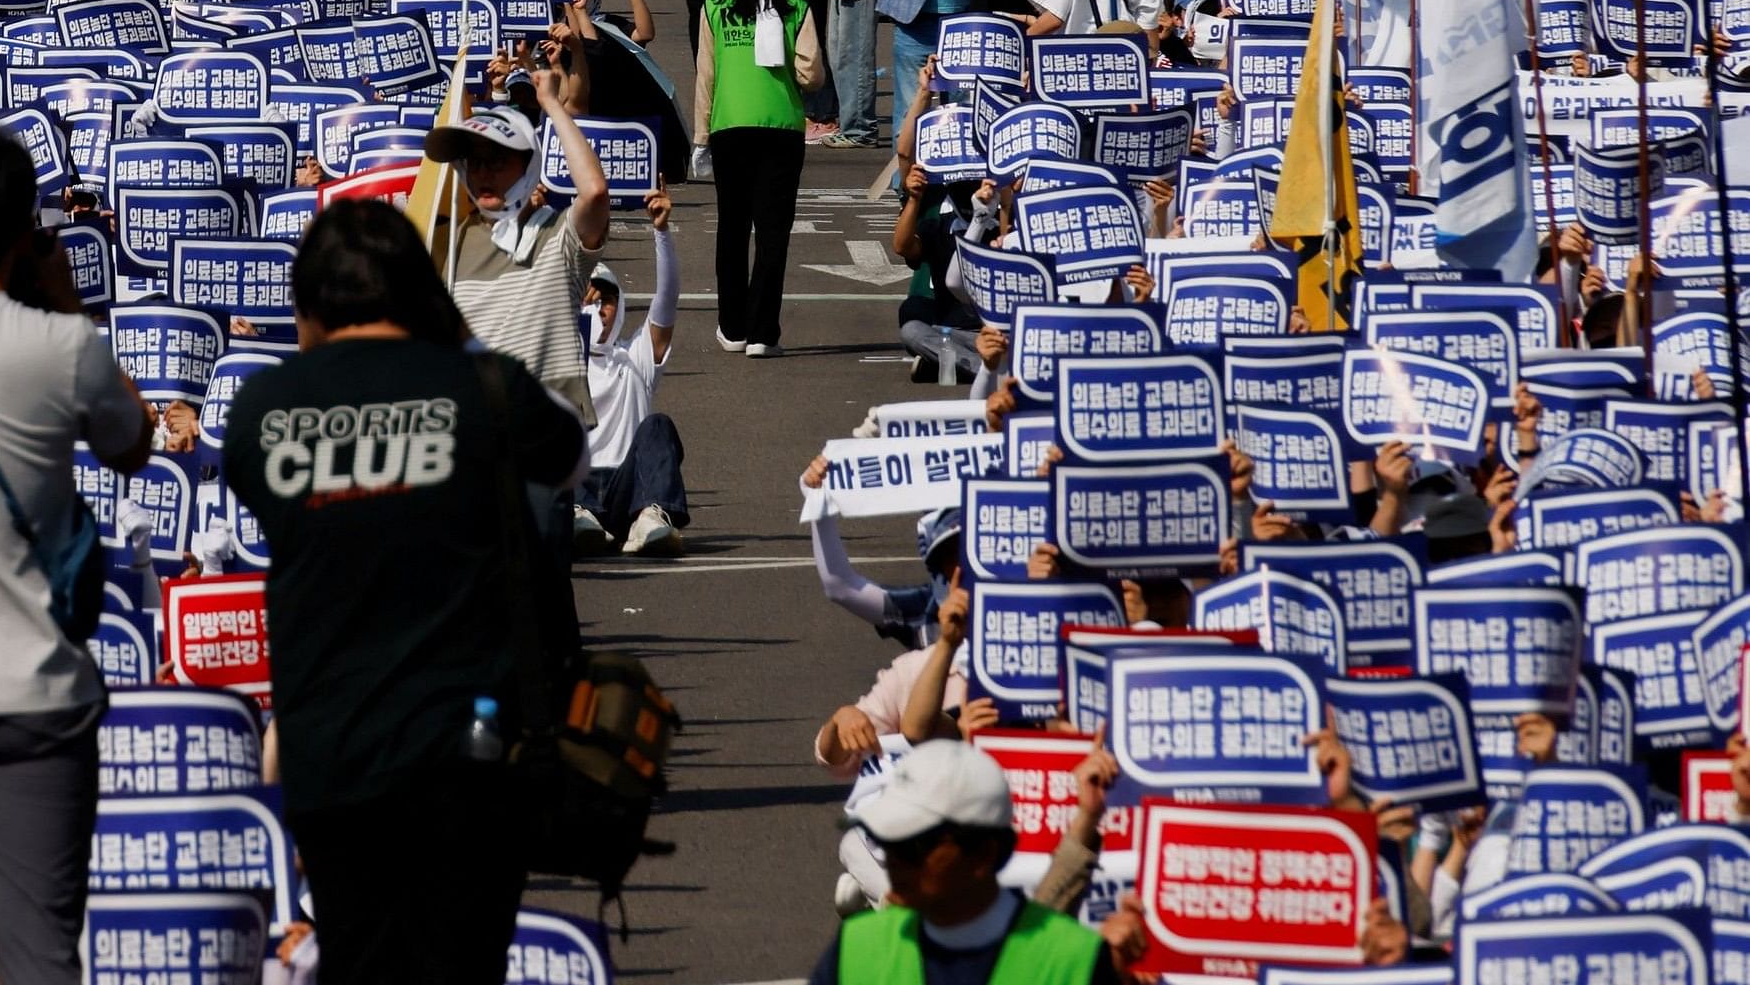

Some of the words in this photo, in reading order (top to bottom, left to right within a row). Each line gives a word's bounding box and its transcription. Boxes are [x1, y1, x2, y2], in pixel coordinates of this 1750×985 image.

[69, 14, 112, 35] 의료농단
[114, 8, 154, 30] 교육농단
[1250, 0, 1287, 15] 필수의료
[1646, 9, 1686, 25] 교육농단
[376, 28, 418, 54] 교육농단
[944, 31, 981, 51] 의료농단
[986, 33, 1019, 52] 교육농단
[1042, 55, 1088, 73] 의료농단
[1093, 53, 1135, 71] 교육농단
[1242, 56, 1285, 74] 의료농단
[162, 70, 208, 89] 의료농단
[211, 69, 258, 89] 교육농단
[1041, 75, 1089, 93] 필수의료
[1094, 73, 1138, 91] 붕괴된다
[1241, 76, 1286, 95] 필수의료
[160, 90, 207, 110] 필수의료
[210, 90, 259, 110] 붕괴된다
[599, 139, 649, 159] 교육농단
[599, 161, 649, 180] 붕괴된다
[129, 207, 181, 229] 의료농단
[185, 207, 233, 229] 교육농단
[185, 284, 238, 307] 필수의료
[243, 284, 293, 307] 붕괴된다
[117, 325, 161, 354] 의료농단
[165, 328, 218, 359] 교육농단
[1025, 328, 1084, 354] 의료농단
[1089, 327, 1150, 352] 교육농단
[1073, 381, 1139, 410] 의료농단
[1147, 378, 1211, 408] 교육농단
[1414, 372, 1476, 408] 교육농단
[260, 399, 457, 452] SPORTS
[1073, 411, 1140, 439] 필수의료
[1146, 409, 1214, 436] 붕괴된다
[1274, 436, 1329, 461] 교육농단
[265, 435, 455, 499] CLUB
[1276, 465, 1334, 489] 붕괴된다
[1070, 489, 1140, 517] 의료농단
[1147, 484, 1213, 515] 교육농단
[979, 505, 1046, 532] 의료농단
[1070, 518, 1141, 551] 필수의료
[1149, 518, 1216, 543] 붕괴된다
[183, 610, 257, 639] 일방적인
[986, 611, 1056, 641] 의료농단
[1431, 619, 1509, 650] 의료농단
[185, 643, 260, 670] 국민건강
[986, 646, 1057, 675] 필수의료
[1129, 687, 1213, 720] 의료농단
[1221, 686, 1304, 719] 교육농단
[1384, 707, 1451, 744] 교육농단
[1130, 725, 1214, 759] 필수의료
[1221, 724, 1304, 757] 붕괴된다
[1380, 737, 1457, 778] 붕괴된다
[176, 828, 267, 865] 교육농단
[1163, 845, 1254, 884] 일방적인
[1259, 849, 1353, 887] 정책추진
[1160, 888, 1253, 924] 국민건강
[1258, 889, 1353, 924] 위협한다
[96, 930, 192, 968] 의료농단
